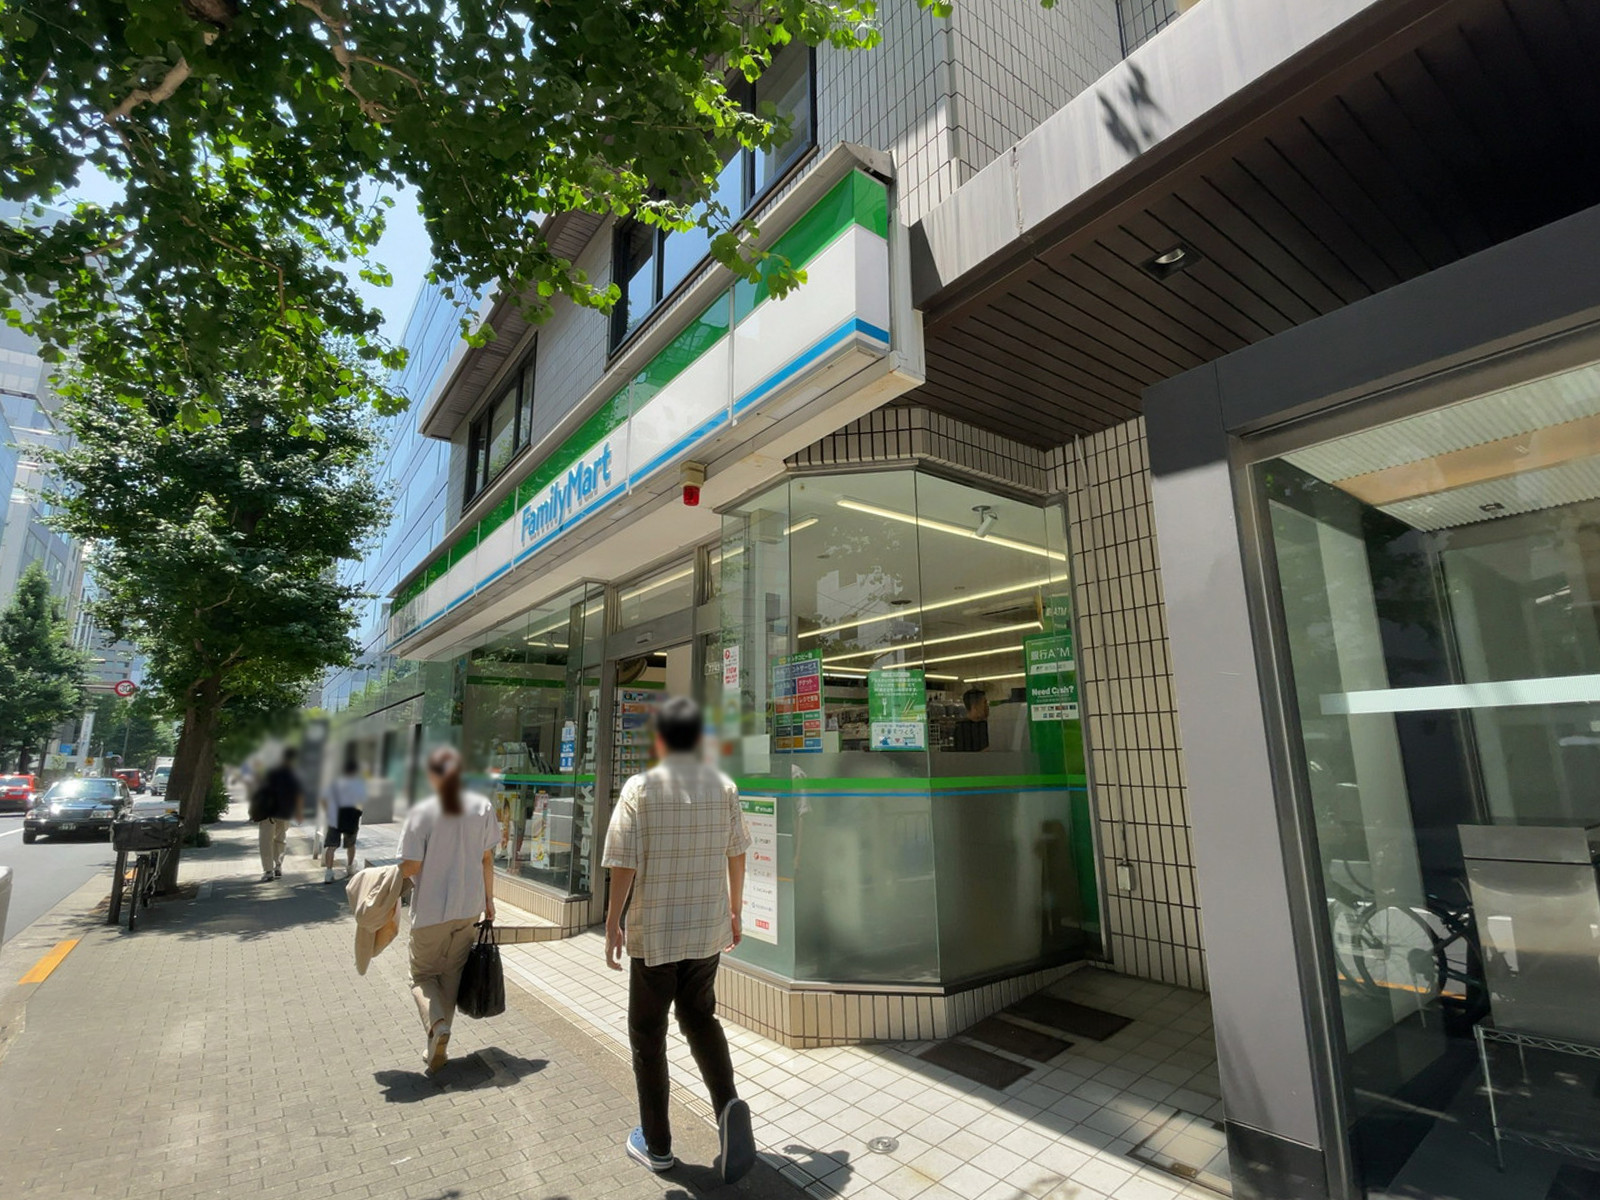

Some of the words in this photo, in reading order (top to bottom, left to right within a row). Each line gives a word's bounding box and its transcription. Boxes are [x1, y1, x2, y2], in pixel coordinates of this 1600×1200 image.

[520, 441, 611, 545] FamilyMart
[1031, 687, 1051, 698] Need
[1051, 685, 1075, 697] Cash?
[578, 689, 600, 891] FamiyMart
